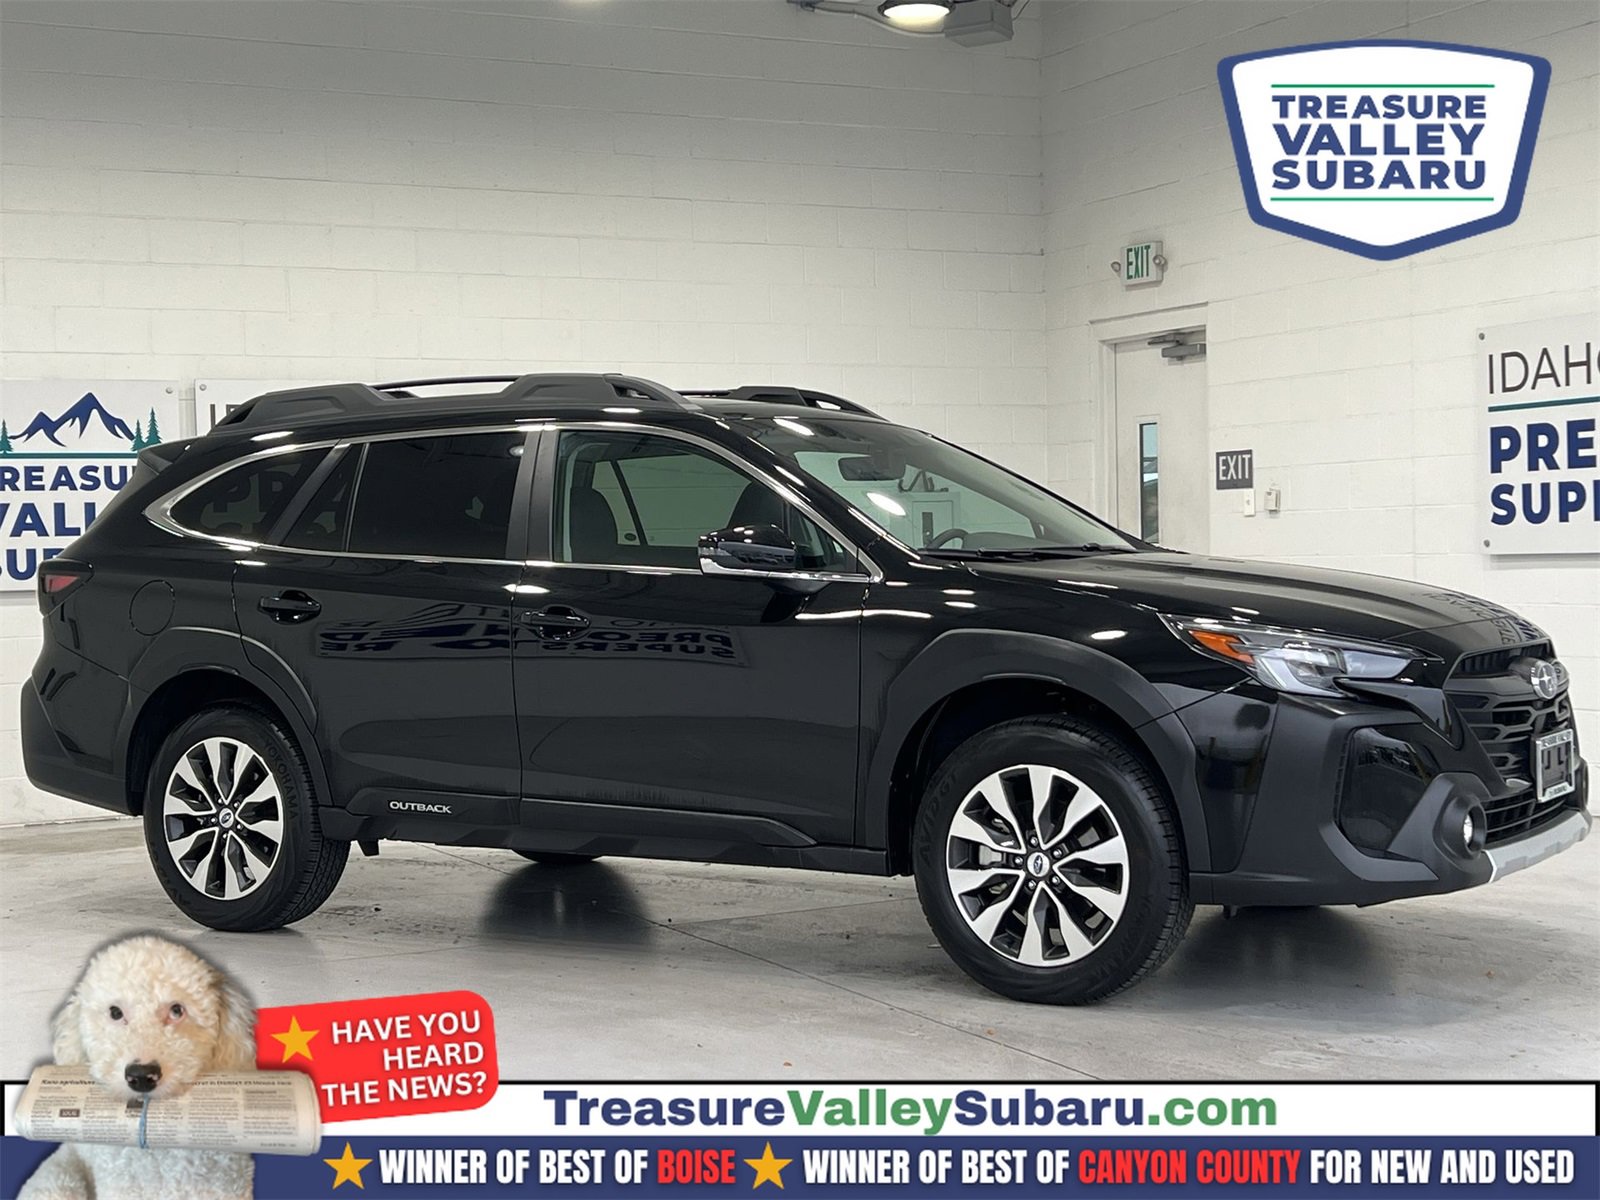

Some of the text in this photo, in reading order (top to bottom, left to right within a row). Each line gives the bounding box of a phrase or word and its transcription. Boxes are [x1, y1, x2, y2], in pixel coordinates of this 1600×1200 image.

[1126, 244, 1151, 280] EXIT
[1488, 342, 1600, 394] IDAH
[0, 465, 137, 491] REASU
[1219, 454, 1251, 481] EXIT
[1490, 479, 1600, 526] SUP
[264, 740, 299, 819] YOKOHAMA
[389, 801, 452, 813] OUTBACK
